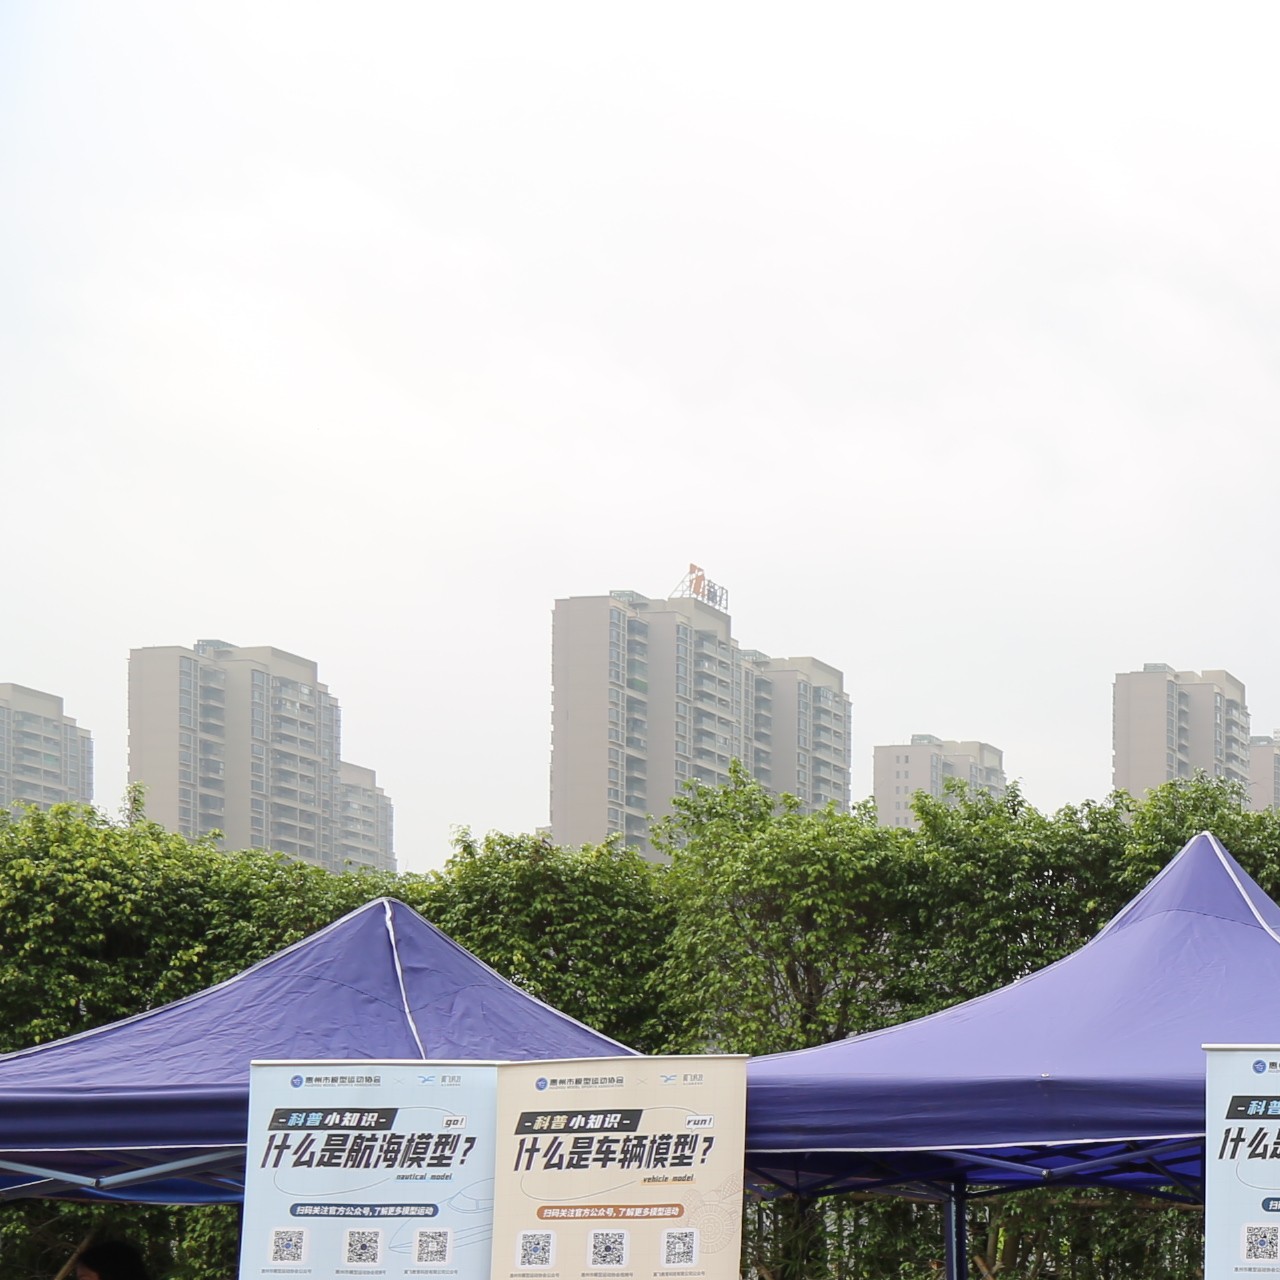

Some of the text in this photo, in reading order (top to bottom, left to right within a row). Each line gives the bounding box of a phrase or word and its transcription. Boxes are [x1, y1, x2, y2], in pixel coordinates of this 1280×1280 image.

[305, 1076, 381, 1084] 惠州市模型运动协会
[550, 1077, 624, 1086] 惠州市模型运动协会
[445, 1118, 464, 1127] go!
[687, 1118, 712, 1126] run!
[672, 1174, 694, 1182] model
